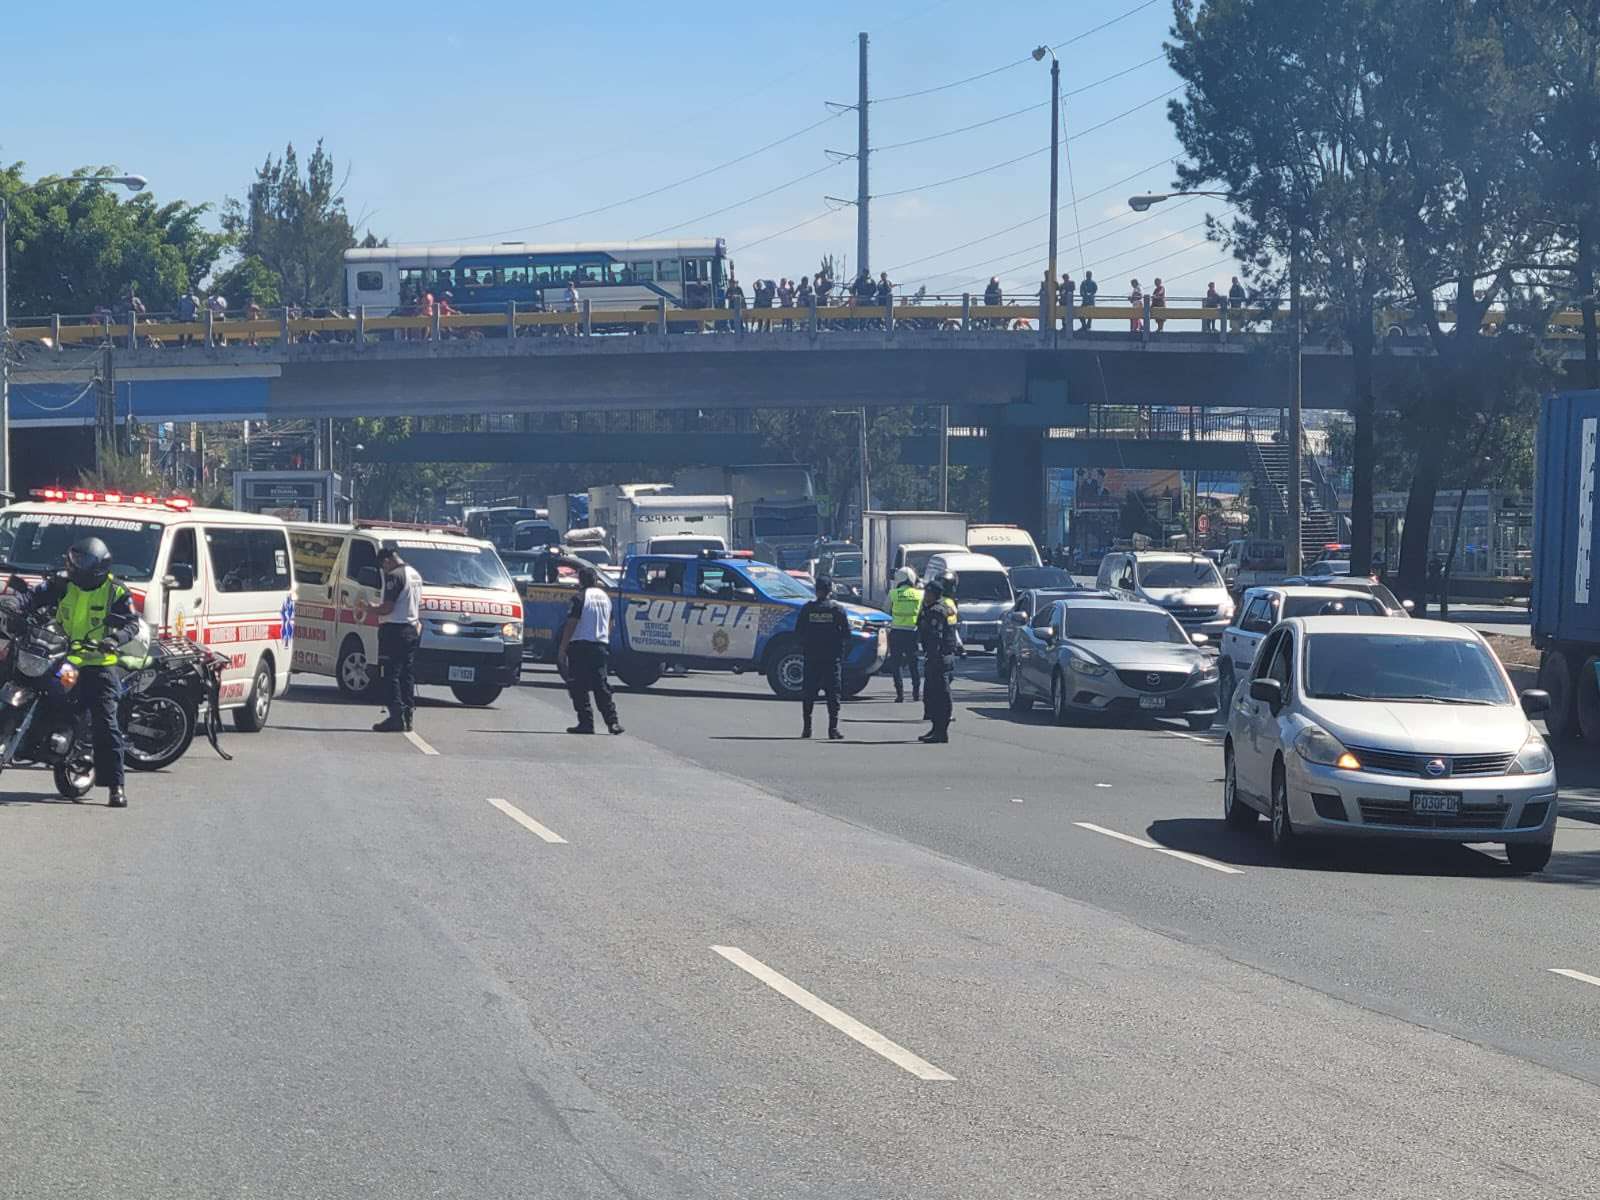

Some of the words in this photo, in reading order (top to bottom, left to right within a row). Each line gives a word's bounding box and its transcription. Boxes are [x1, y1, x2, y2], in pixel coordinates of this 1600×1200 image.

[19, 514, 74, 526] BOMBEROS
[75, 518, 143, 532] VOLUNTARIOS
[644, 622, 670, 631] SERVICIO
[640, 630, 673, 639] INTEGRIDAD
[632, 636, 681, 648] PROFESIONALISMO
